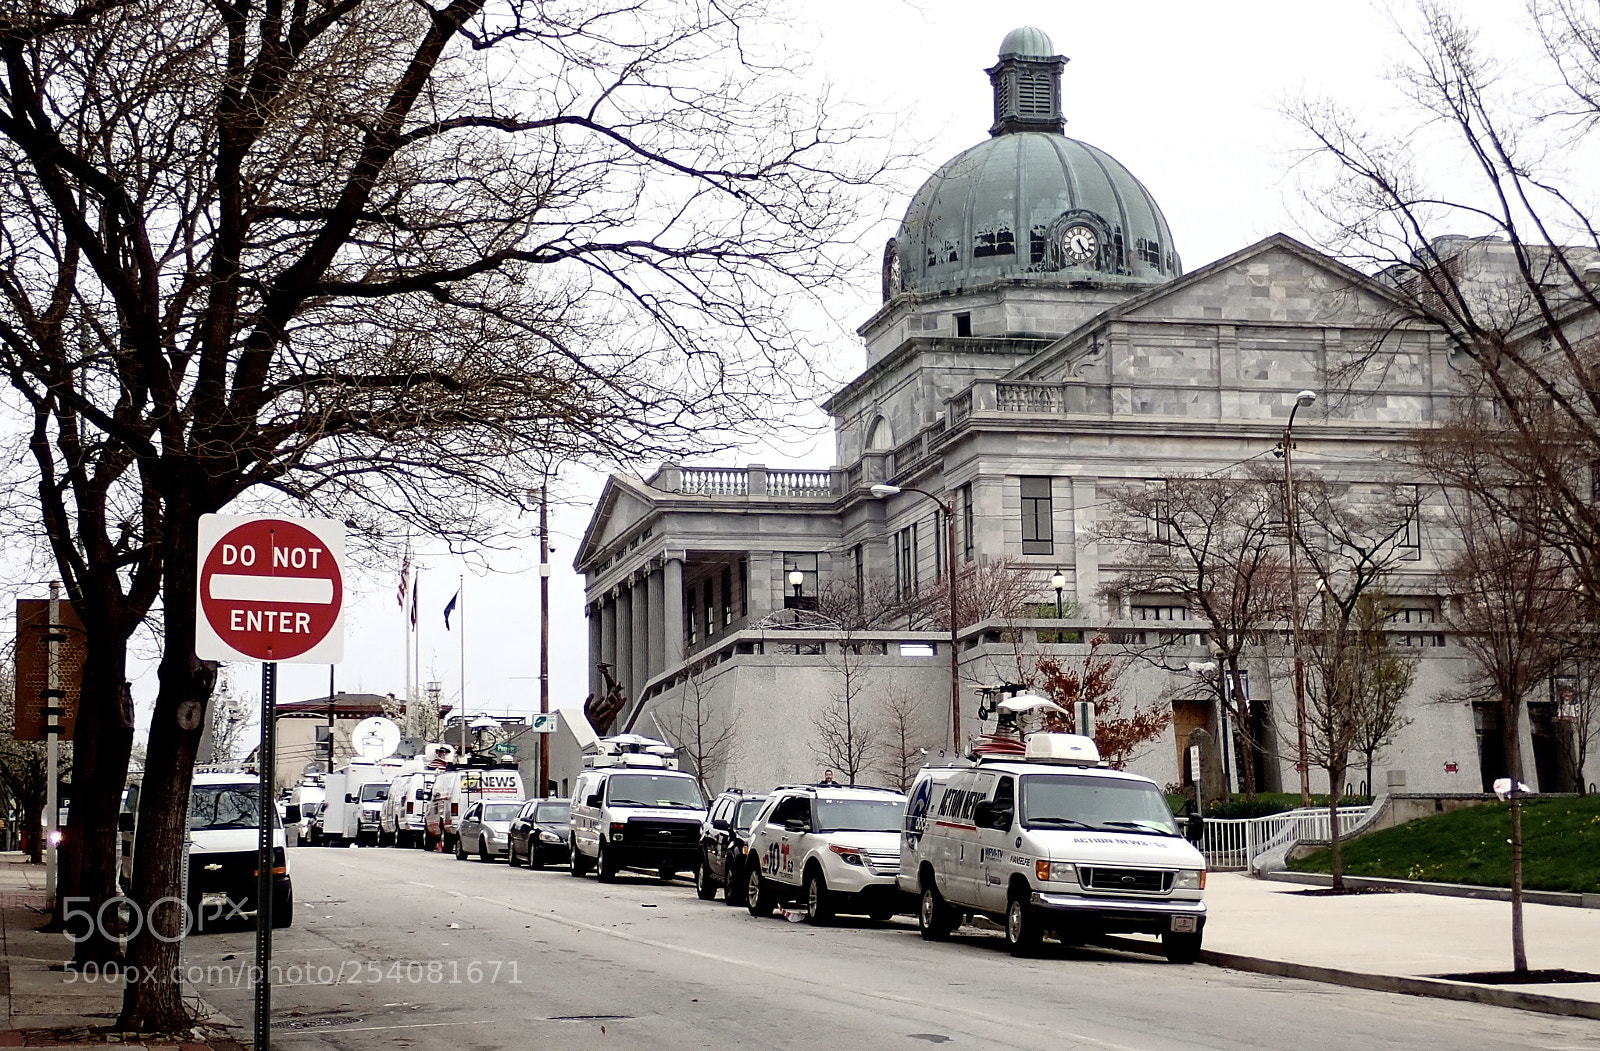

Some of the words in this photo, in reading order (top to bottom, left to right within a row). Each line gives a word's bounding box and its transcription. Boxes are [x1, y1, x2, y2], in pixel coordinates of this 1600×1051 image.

[222, 544, 256, 567] DO
[273, 546, 322, 569] NOT
[230, 609, 311, 634] ENTER
[479, 776, 516, 787] NEWS
[937, 788, 967, 818] ACTION
[1115, 838, 1149, 846] NEWS
